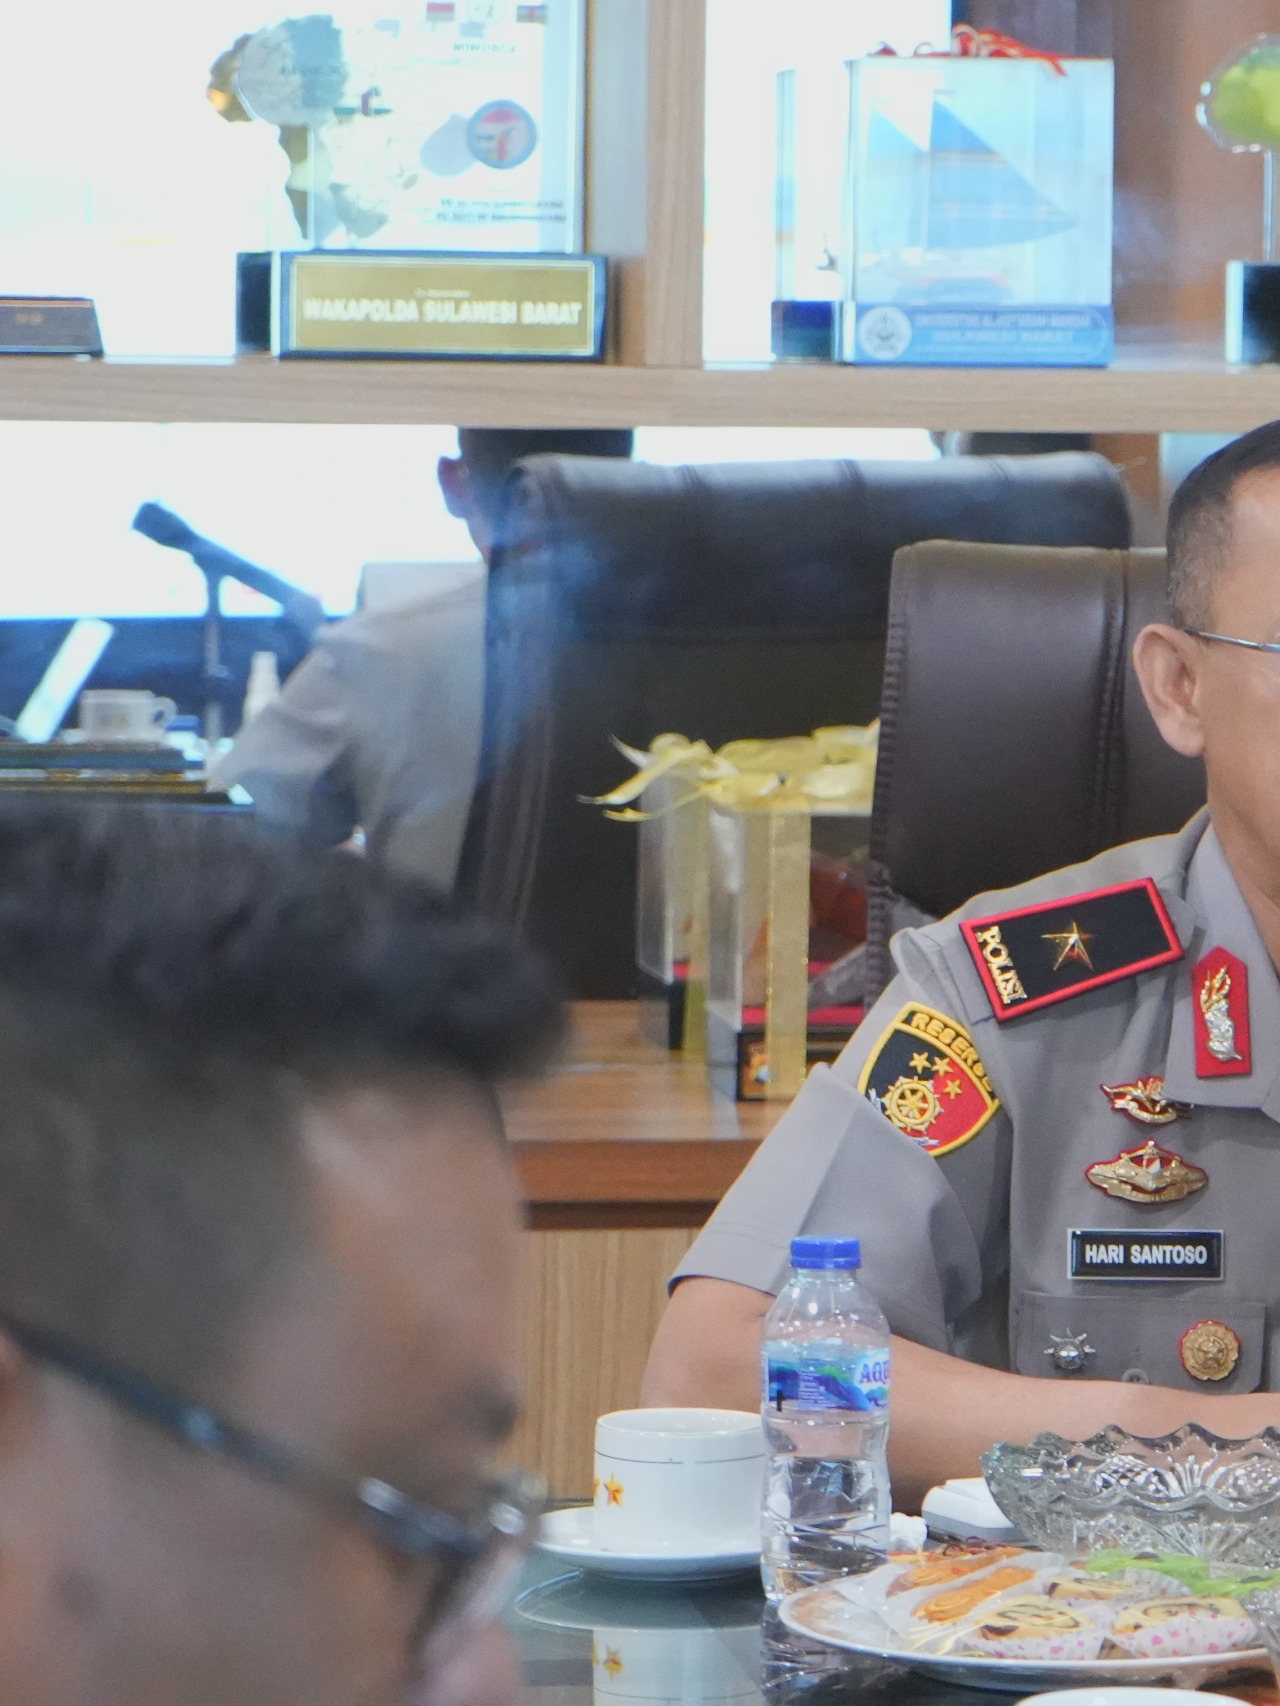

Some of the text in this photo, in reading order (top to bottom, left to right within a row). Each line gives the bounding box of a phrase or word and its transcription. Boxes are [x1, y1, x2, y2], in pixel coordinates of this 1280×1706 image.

[304, 299, 582, 325] WAKAPOLDA SULAWESI BARAT
[975, 925, 1028, 1004] POLISI
[1085, 1244, 1208, 1265] HARI SANTOSO
